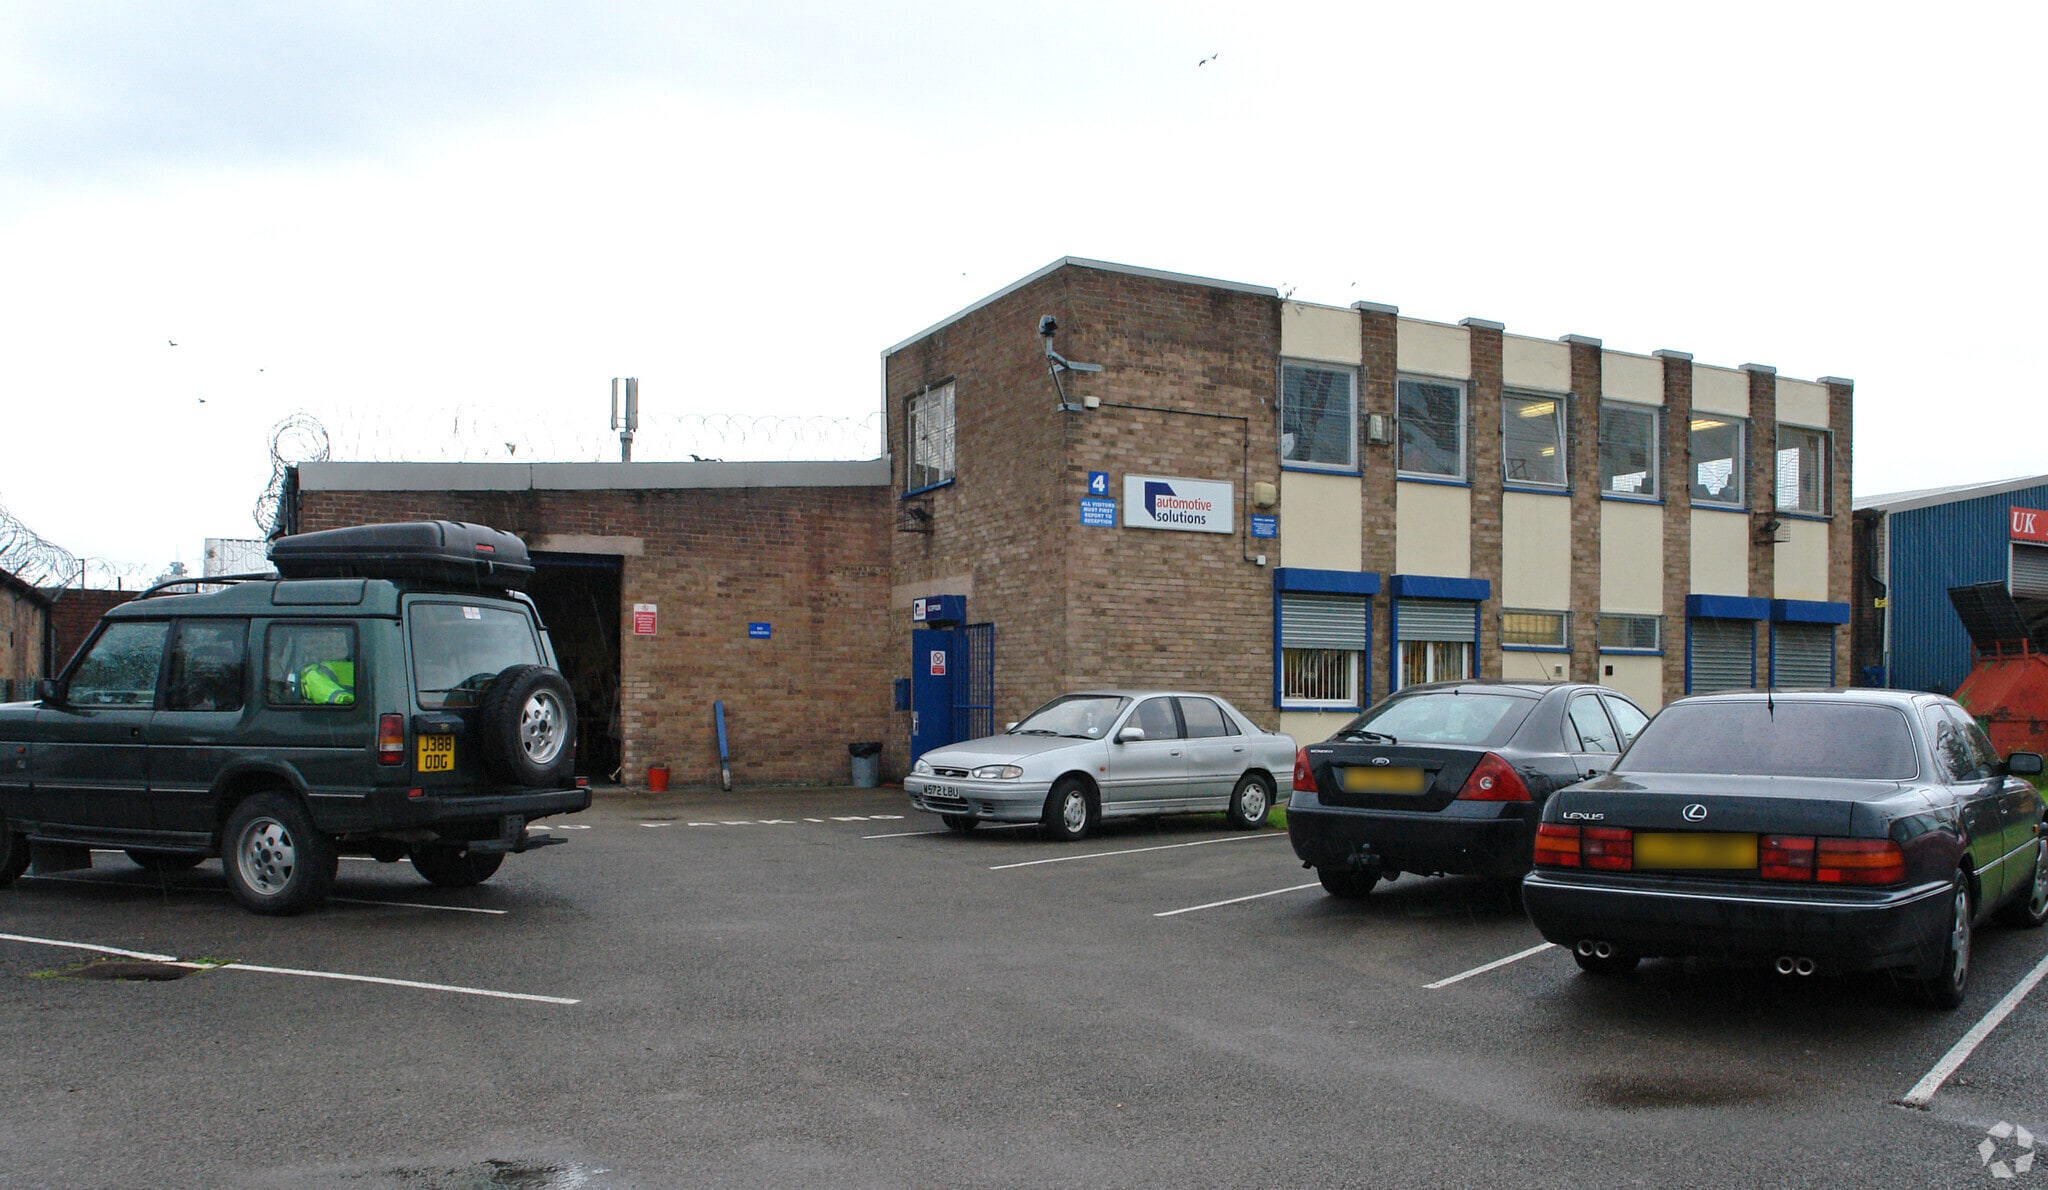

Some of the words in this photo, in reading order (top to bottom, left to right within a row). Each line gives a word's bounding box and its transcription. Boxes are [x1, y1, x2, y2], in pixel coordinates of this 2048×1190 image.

[1092, 474, 1106, 492] 4
[1156, 497, 1212, 511] automotive
[1156, 509, 1207, 525] solutions
[2012, 511, 2037, 534] UK
[422, 735, 452, 752] J388
[425, 754, 448, 769] ODG
[942, 786, 959, 797] LBU
[1562, 811, 1605, 821] LEXUS
